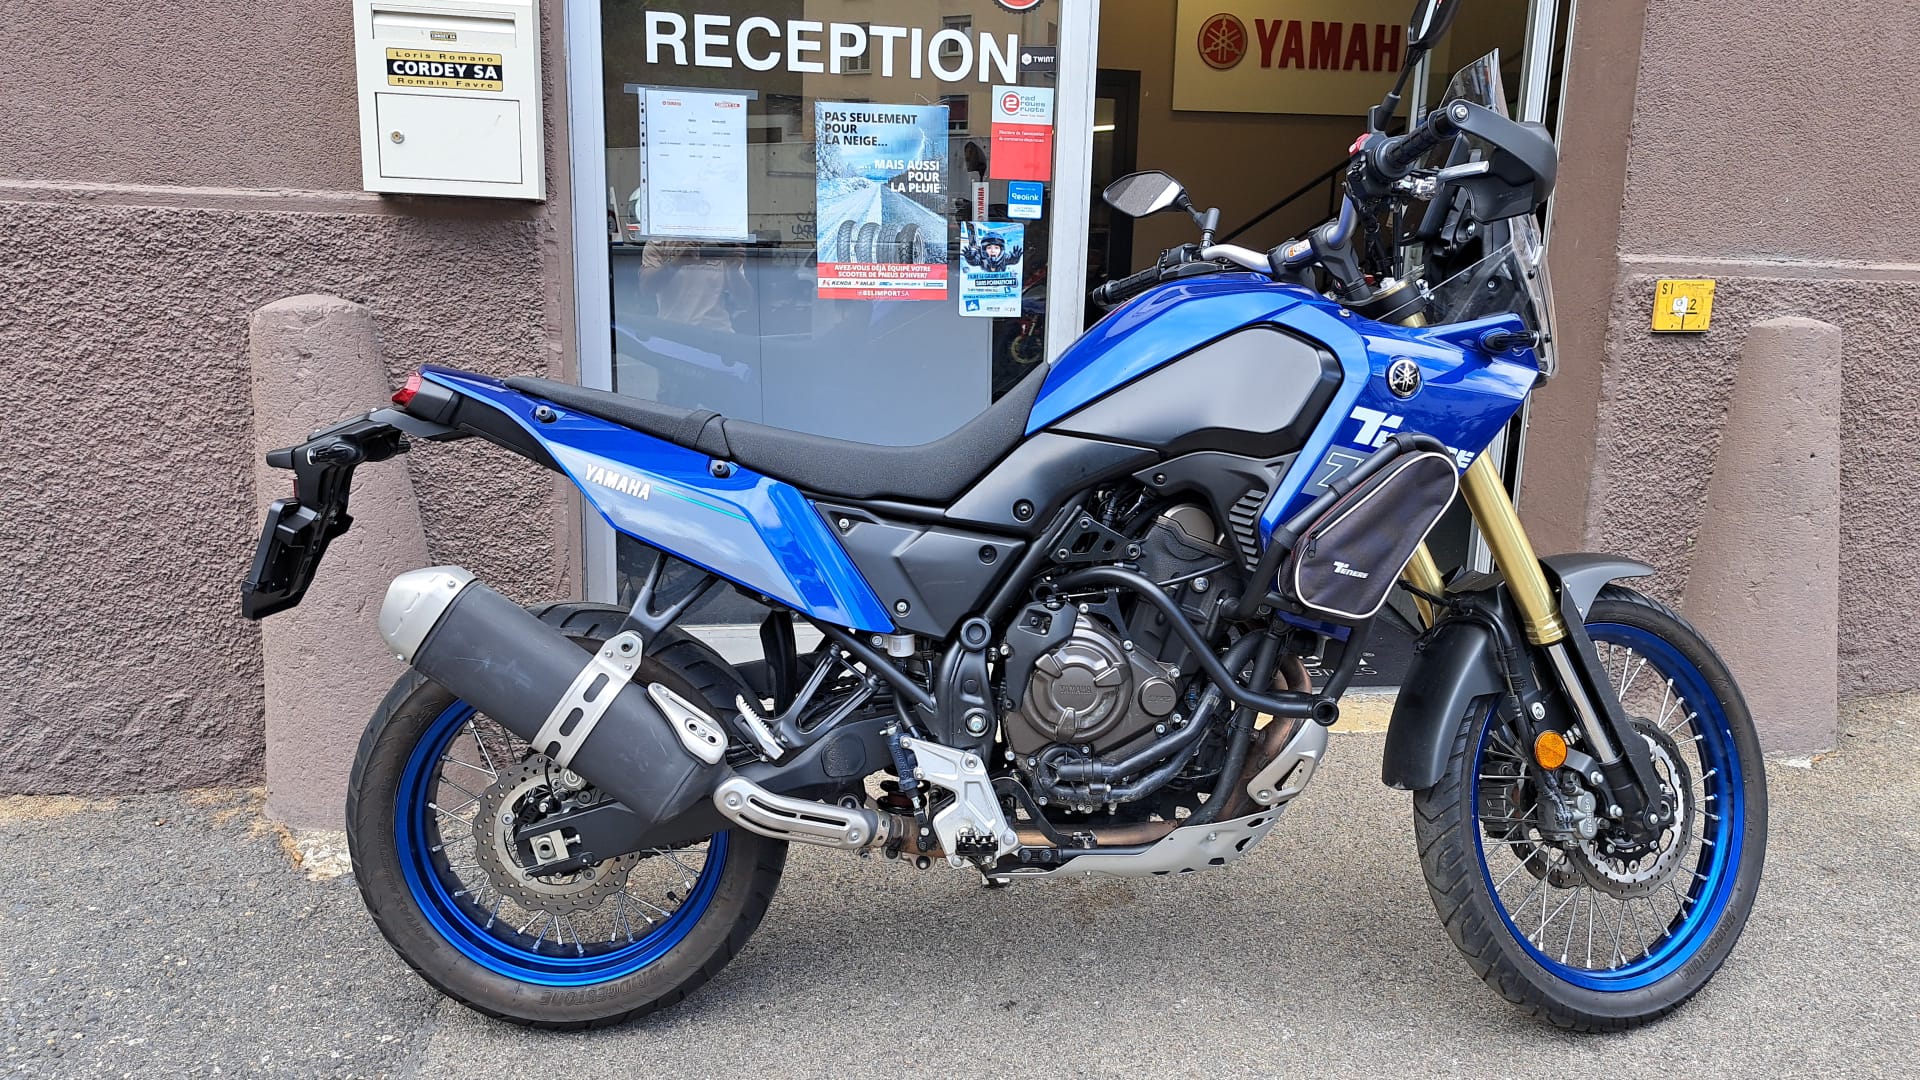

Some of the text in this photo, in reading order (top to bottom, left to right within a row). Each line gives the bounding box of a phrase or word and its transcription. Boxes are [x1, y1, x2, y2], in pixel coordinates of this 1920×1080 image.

[645, 10, 1019, 84] RECEPTION
[1254, 18, 1402, 72] YAMAH
[395, 51, 493, 62] Loris Romano
[1032, 55, 1055, 63] TWINT
[392, 60, 498, 79] CORDEY SA
[397, 77, 494, 89] Romain Favre
[824, 111, 918, 125] PAS SEULEMENT
[825, 123, 857, 134] POUR
[825, 135, 840, 145] LA
[874, 159, 904, 170] MAIS
[907, 160, 940, 171] AUSSI
[908, 171, 940, 182] POUR
[890, 182, 940, 194] LA PLUIE
[977, 187, 985, 215] YAMAHA
[584, 463, 652, 501] YAMAHA
